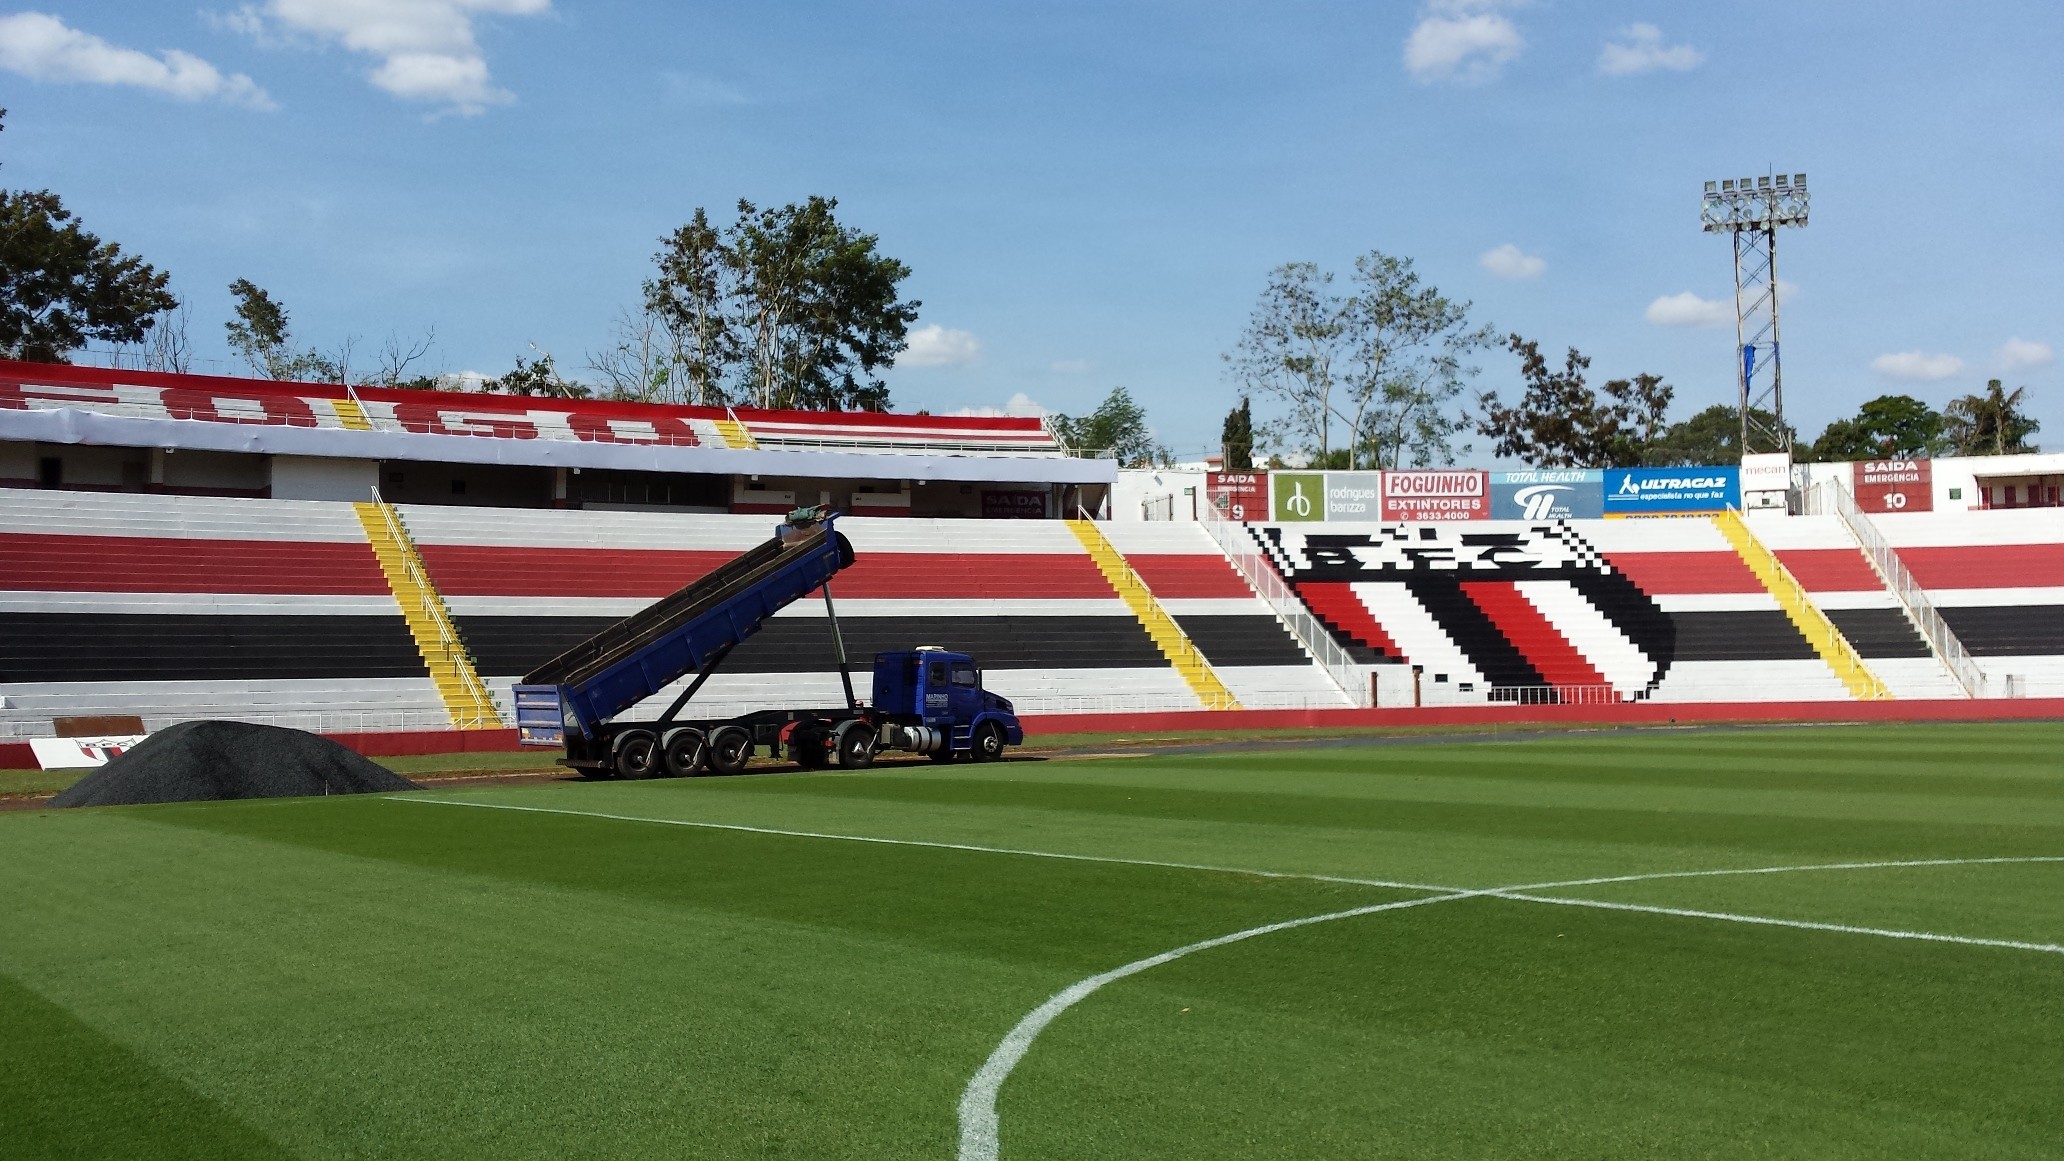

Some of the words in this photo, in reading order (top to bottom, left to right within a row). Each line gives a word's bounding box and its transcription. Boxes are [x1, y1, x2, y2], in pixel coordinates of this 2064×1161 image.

[1745, 466, 1786, 475] mecan
[1506, 472, 1539, 483] TOTAL
[1541, 471, 1587, 482] HEALTH
[1390, 475, 1478, 493] FOGUINHO
[1640, 477, 1727, 490] ULTRAGAZ
[1329, 486, 1375, 500] rodrigues
[1640, 492, 1682, 501] especialista
[1694, 492, 1710, 500] que
[1388, 499, 1482, 511] EXTINTORES
[1883, 492, 1907, 509] 10
[1232, 504, 1245, 520] 9
[1330, 501, 1366, 513] barizza
[1416, 511, 1470, 520] 3633.4000
